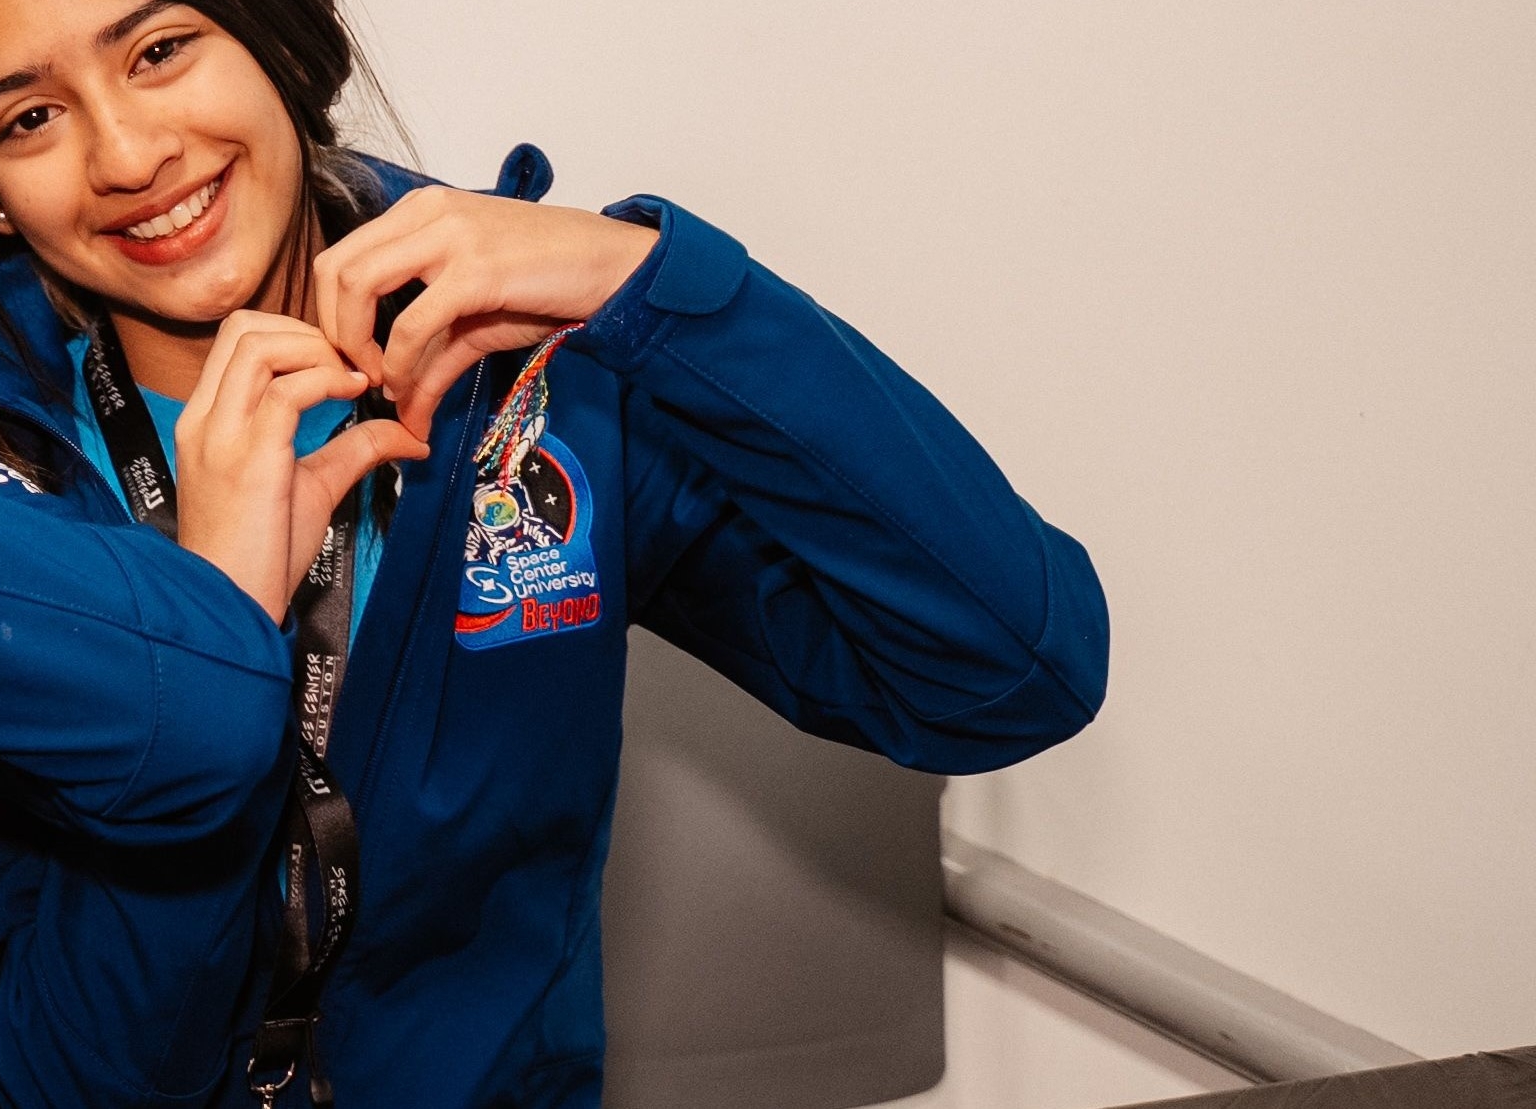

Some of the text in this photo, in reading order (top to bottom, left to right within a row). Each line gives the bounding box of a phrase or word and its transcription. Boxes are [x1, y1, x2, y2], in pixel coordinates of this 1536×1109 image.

[506, 548, 560, 572] Space
[510, 560, 568, 585] Center
[513, 571, 596, 599] University
[303, 652, 322, 714] CENTER
